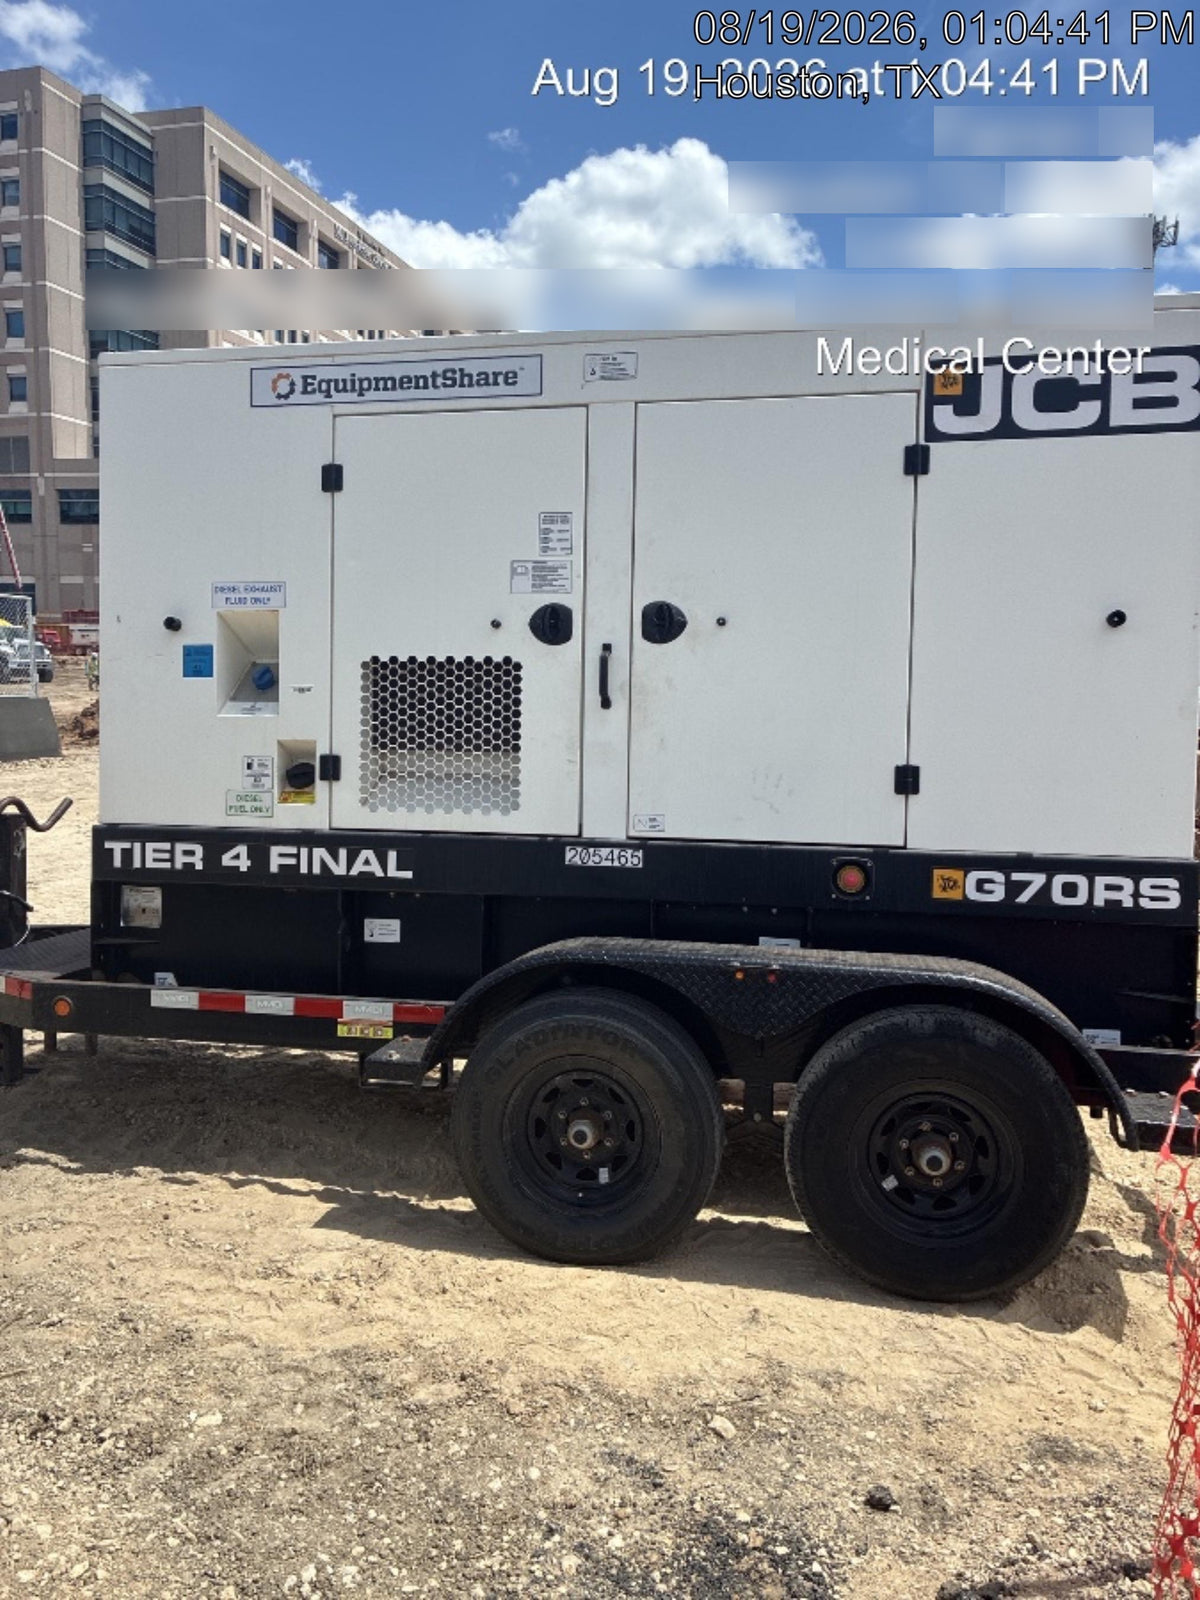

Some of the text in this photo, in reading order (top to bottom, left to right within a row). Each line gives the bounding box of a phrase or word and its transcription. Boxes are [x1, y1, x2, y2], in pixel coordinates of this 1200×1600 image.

[300, 368, 518, 398] EquipmentShare
[933, 354, 1200, 435] JCB
[104, 841, 413, 879] TIER 4 FINAL
[568, 847, 641, 867] 205465
[965, 870, 1182, 909] G70RS
